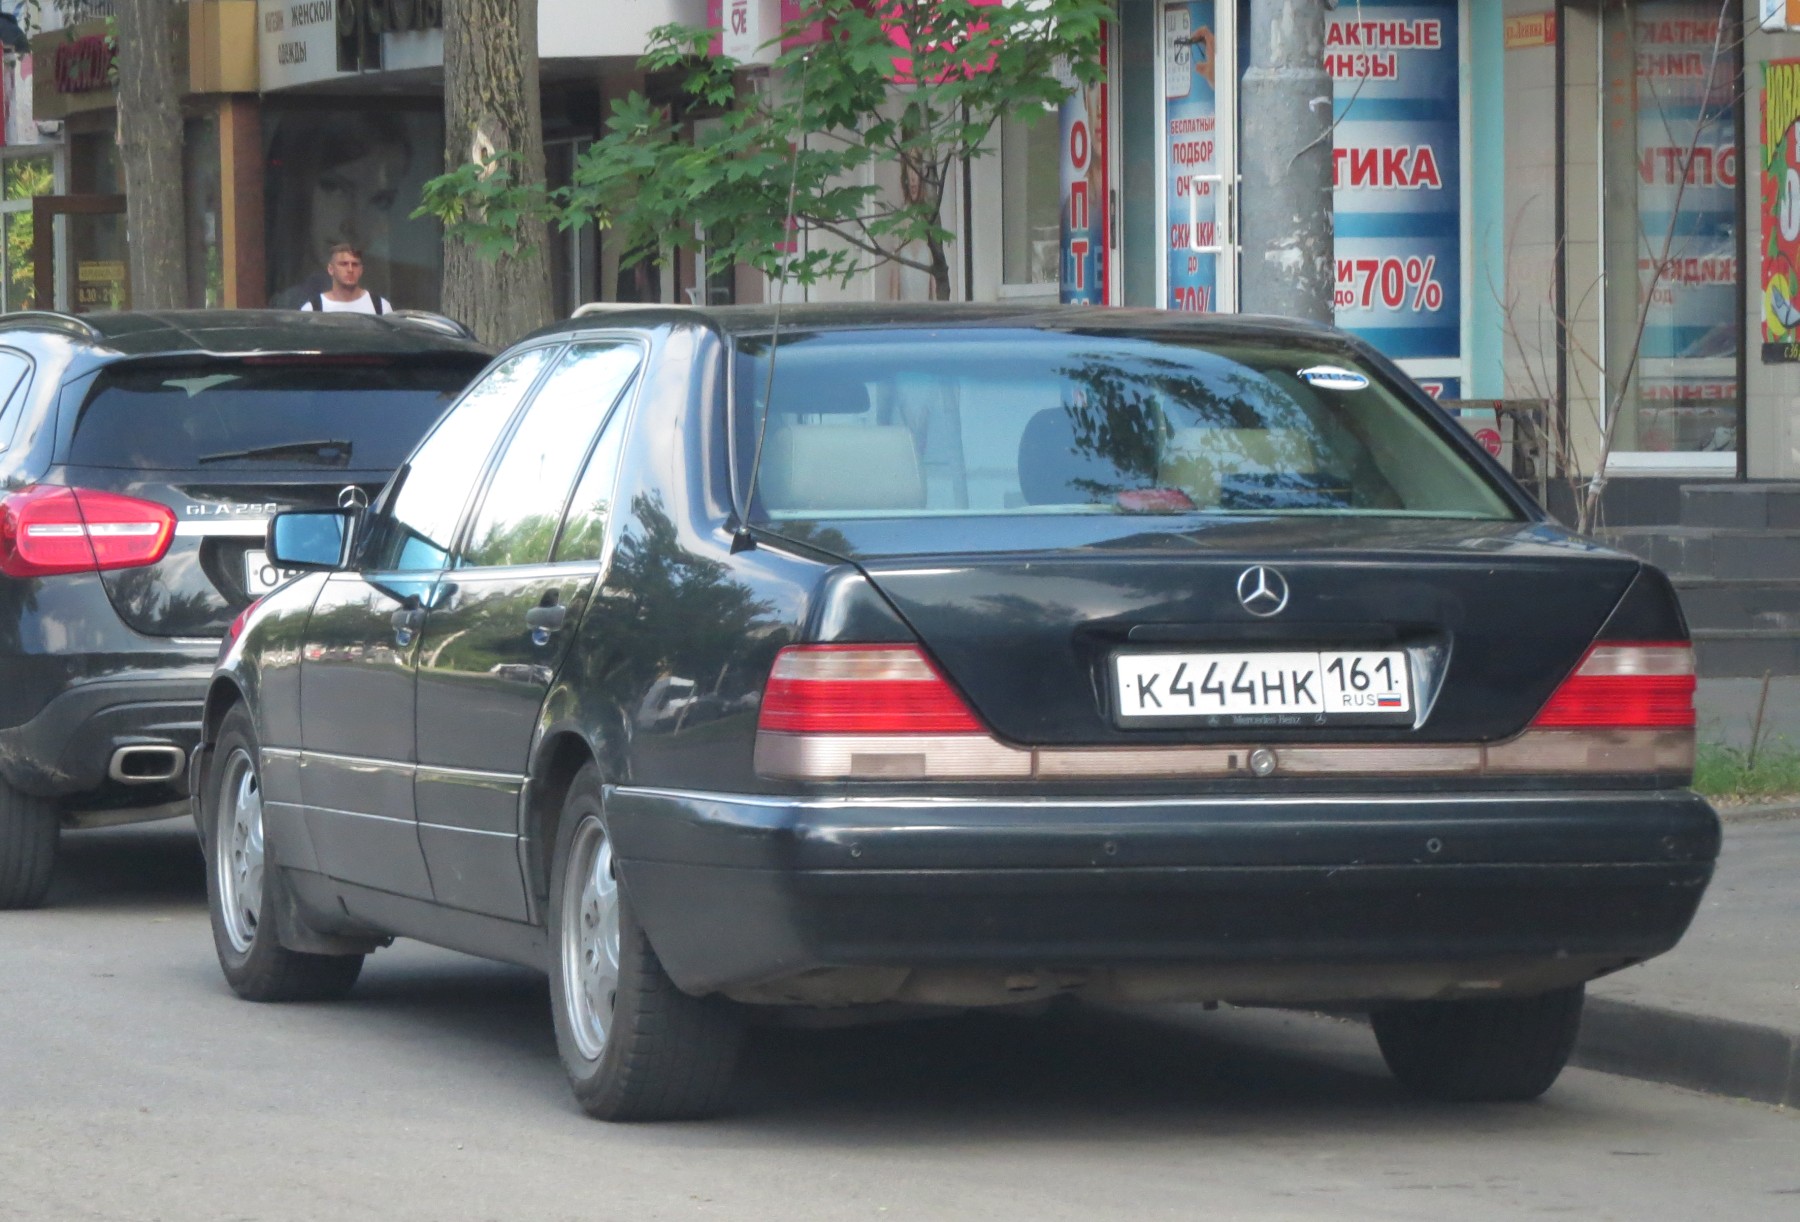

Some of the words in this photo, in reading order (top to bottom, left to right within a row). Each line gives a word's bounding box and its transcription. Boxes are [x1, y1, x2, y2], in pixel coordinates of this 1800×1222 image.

[1173, 141, 1213, 167] ПОДБОР
[1176, 175, 1210, 197] ОЧОВ
[1070, 120, 1090, 305] ОПТ
[1356, 258, 1442, 310] 70%
[186, 504, 231, 515] GLA
[1137, 660, 1318, 709] К444НК
[1327, 657, 1394, 692] 161
[1343, 693, 1376, 707] RUS
